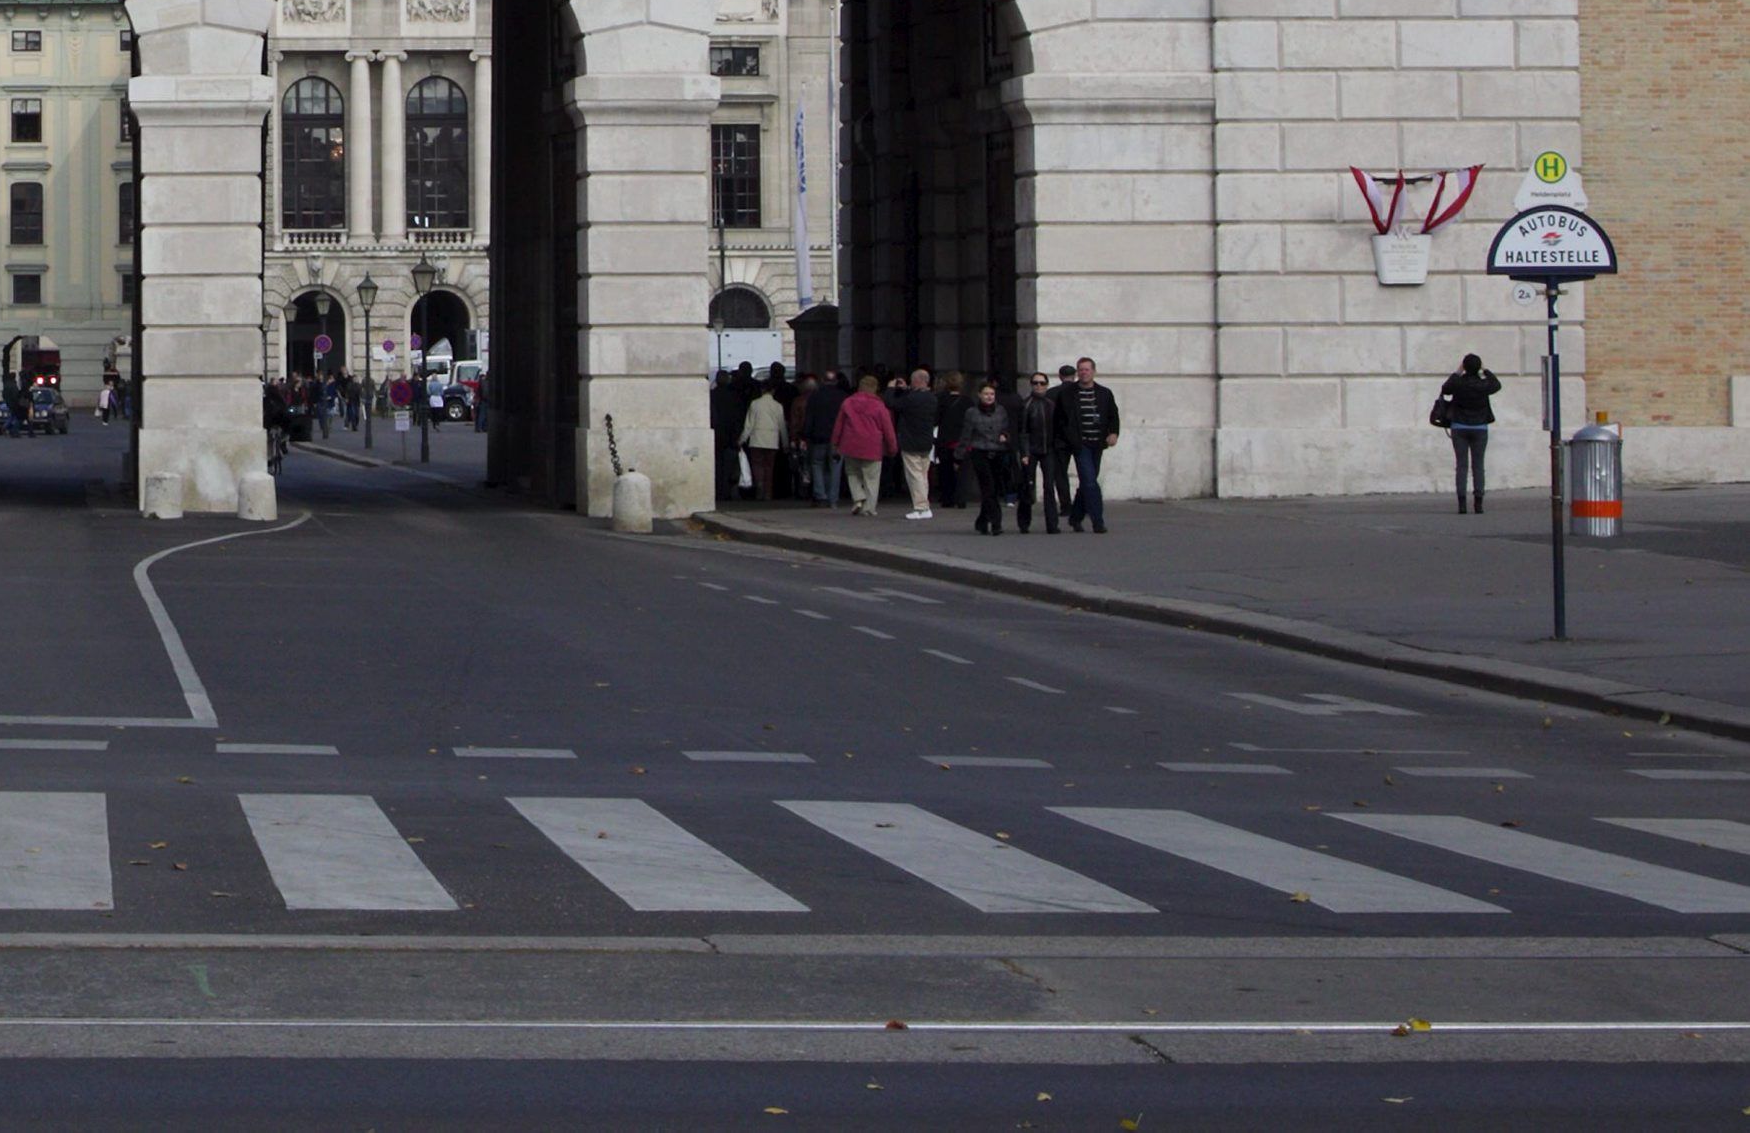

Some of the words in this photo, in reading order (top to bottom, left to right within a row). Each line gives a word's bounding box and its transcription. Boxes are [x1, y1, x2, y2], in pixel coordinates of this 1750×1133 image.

[1542, 157, 1559, 177] H
[1517, 214, 1588, 238] AUTOBUS
[1505, 250, 1599, 263] HALTESTELLE
